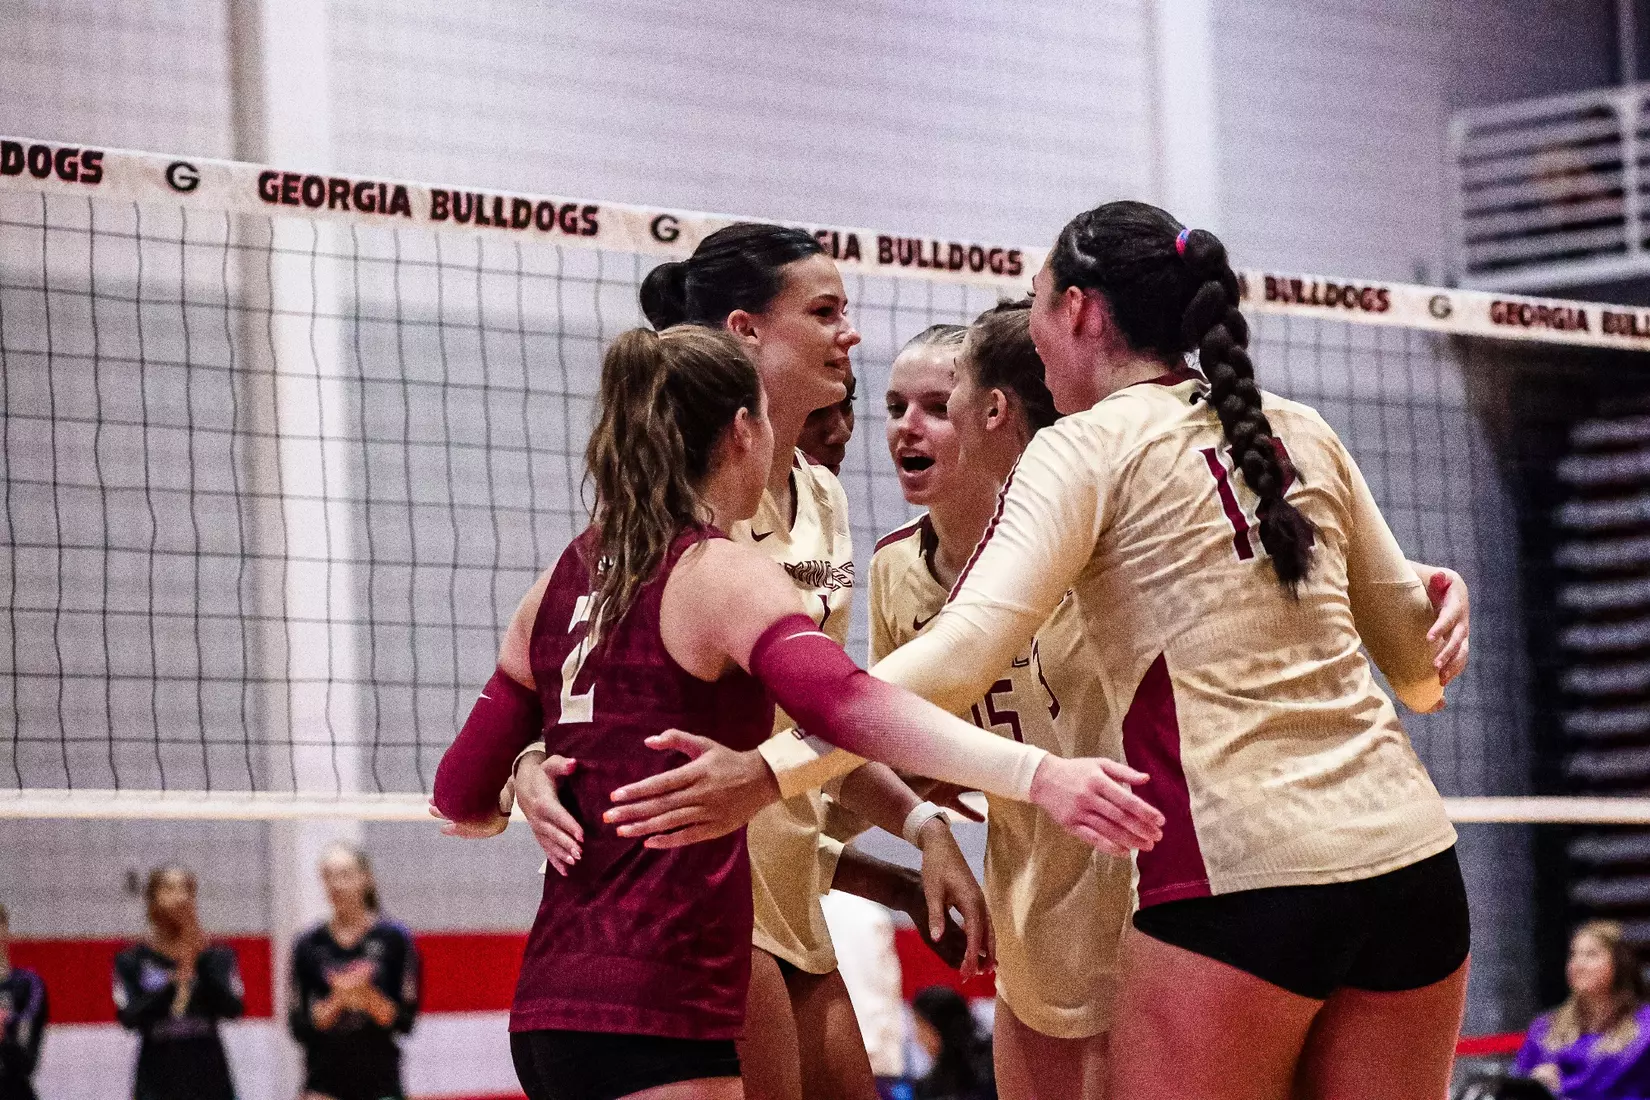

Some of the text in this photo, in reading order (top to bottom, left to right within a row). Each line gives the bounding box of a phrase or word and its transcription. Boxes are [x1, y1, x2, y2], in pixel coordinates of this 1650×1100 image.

[1, 139, 104, 184] DOGS
[165, 161, 200, 192] G
[258, 170, 599, 236] GEORGIA BULLDOGS
[651, 213, 680, 242] G
[877, 235, 1023, 276] BULLDOGS
[1265, 275, 1389, 312] BULLDOGS
[1428, 294, 1453, 319] G
[1491, 300, 1589, 332] GEORGIA
[558, 591, 611, 725] 2
